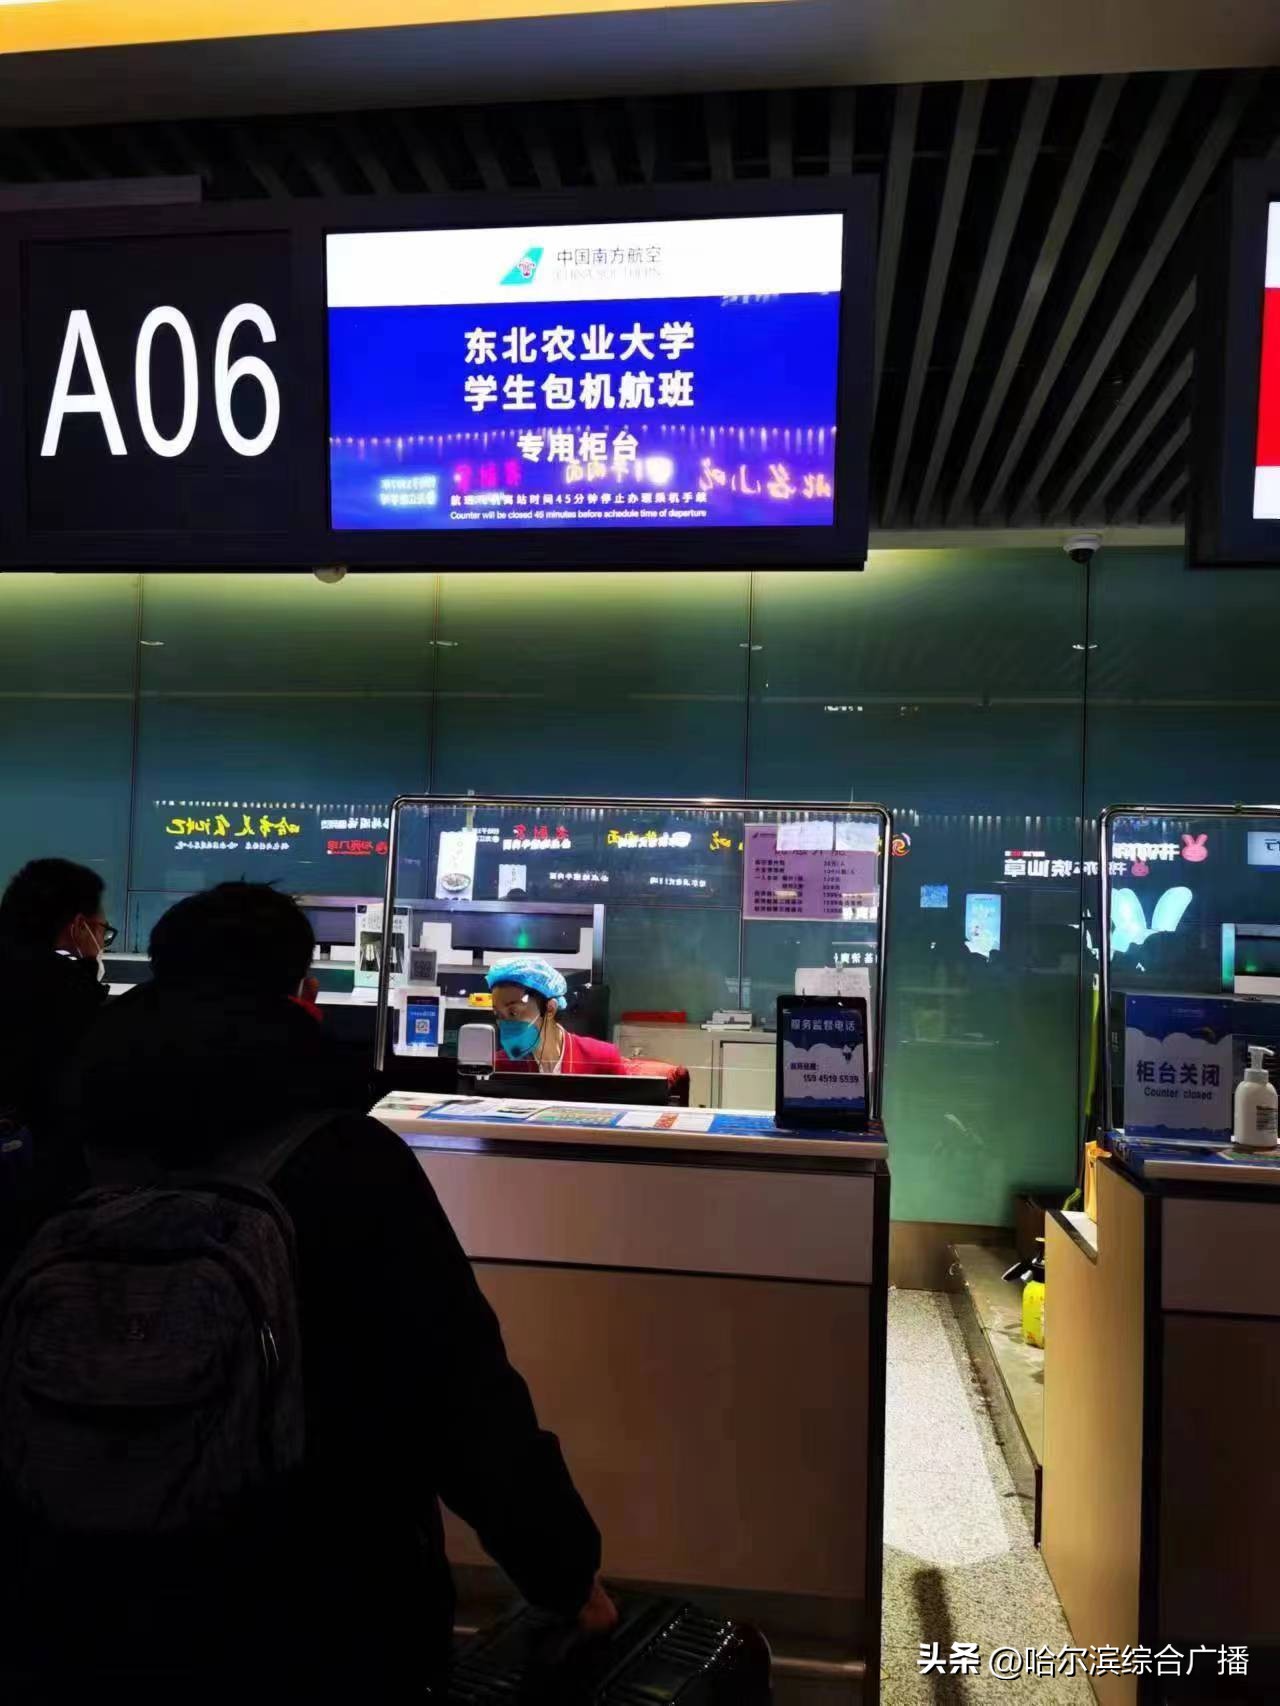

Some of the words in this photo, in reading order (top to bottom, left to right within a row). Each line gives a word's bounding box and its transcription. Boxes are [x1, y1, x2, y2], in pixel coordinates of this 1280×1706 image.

[556, 244, 662, 267] 中国南方航空
[463, 321, 696, 366] 东北农业大学
[40, 303, 280, 457] A06
[463, 369, 696, 413] 学生包机航班
[516, 430, 640, 464] 专用柜台
[450, 492, 707, 506] 航班离站时间45分钟停止办理乘机手续
[450, 511, 481, 520] Counter
[482, 511, 496, 519] will
[497, 511, 507, 519] be
[508, 510, 533, 519] closed
[546, 510, 577, 519] minutes
[578, 510, 603, 519] before
[604, 509, 639, 519] schedule
[640, 509, 658, 518] time
[659, 509, 668, 518] of
[790, 1018, 856, 1032] 服务监督电话
[1136, 1060, 1220, 1087] 柜台关闭
[1143, 1086, 1179, 1099] Counter
[1183, 1089, 1213, 1101] closed
